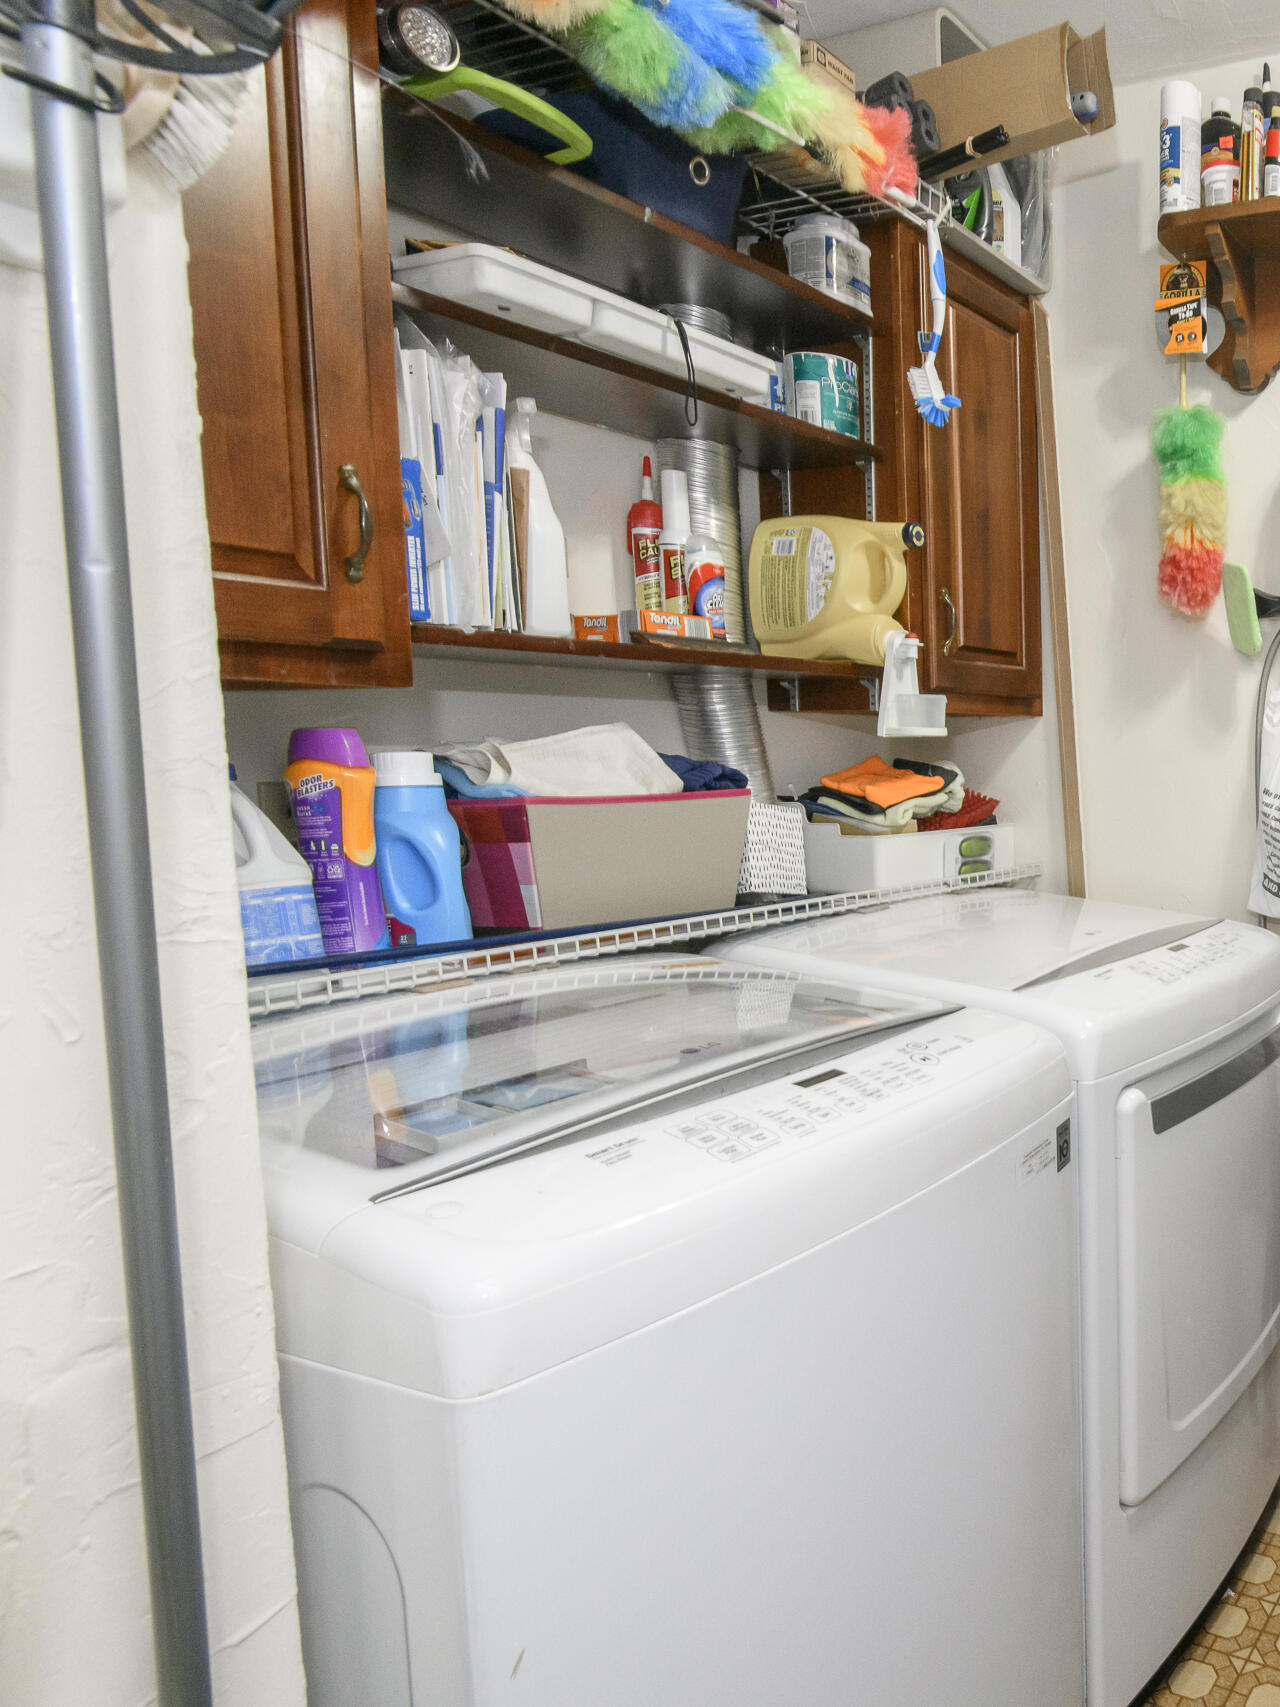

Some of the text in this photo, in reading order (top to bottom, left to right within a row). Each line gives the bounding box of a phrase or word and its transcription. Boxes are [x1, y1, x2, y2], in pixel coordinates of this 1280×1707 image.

[1164, 290, 1201, 299] GORILLA
[583, 616, 607, 628] Tandil
[649, 613, 681, 625] Tandil
[299, 774, 322, 788] ODOR
[296, 778, 334, 798] BLASTERS
[1263, 879, 1278, 893] AND
